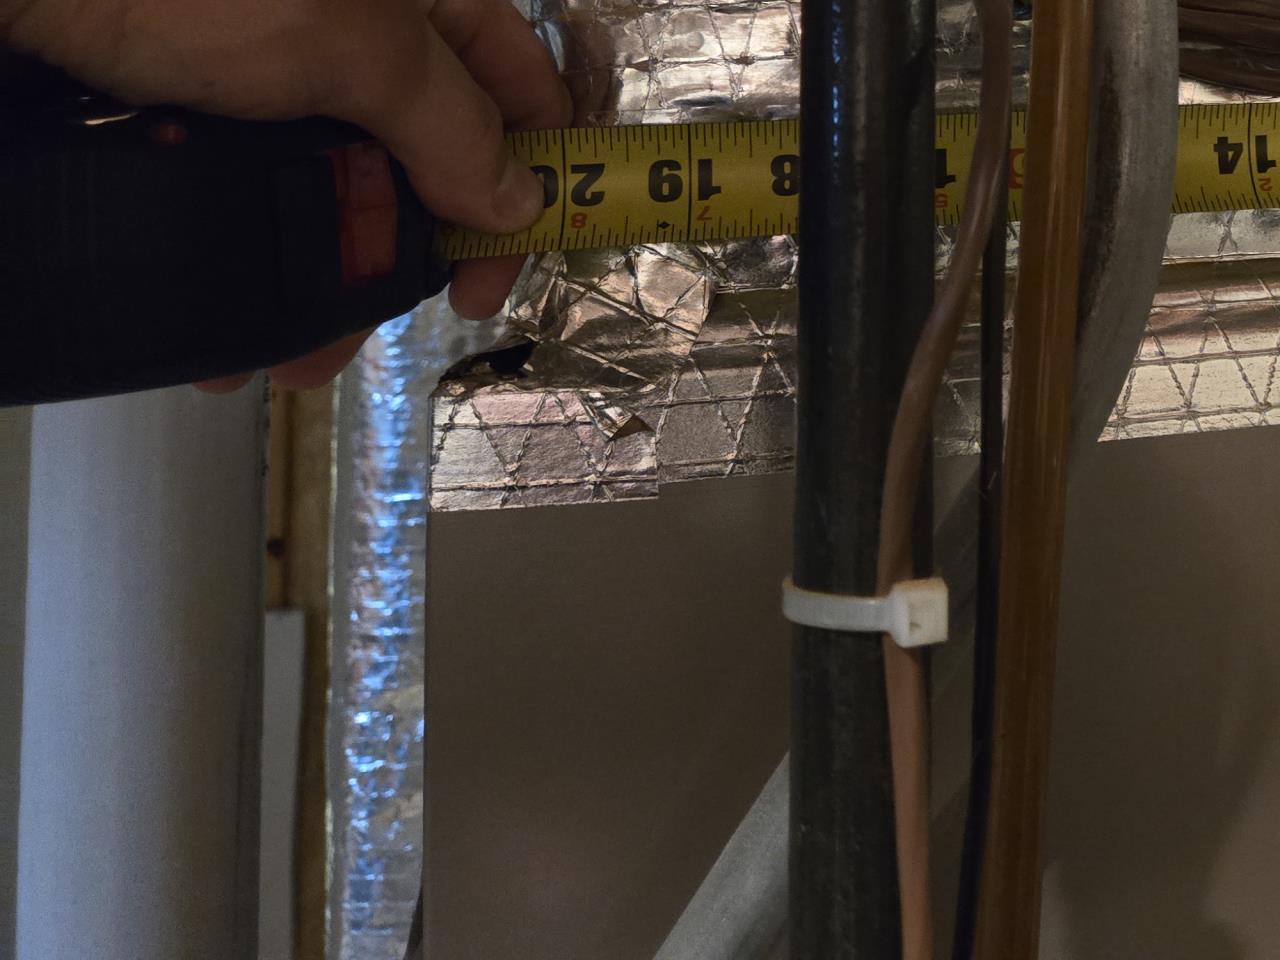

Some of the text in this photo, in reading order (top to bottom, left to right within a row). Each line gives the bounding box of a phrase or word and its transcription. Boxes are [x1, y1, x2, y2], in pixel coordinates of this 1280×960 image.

[1213, 134, 1277, 175] 14
[647, 158, 722, 203] 19
[1257, 177, 1274, 192] 2
[570, 211, 588, 229] 8
[695, 205, 713, 222] 7
